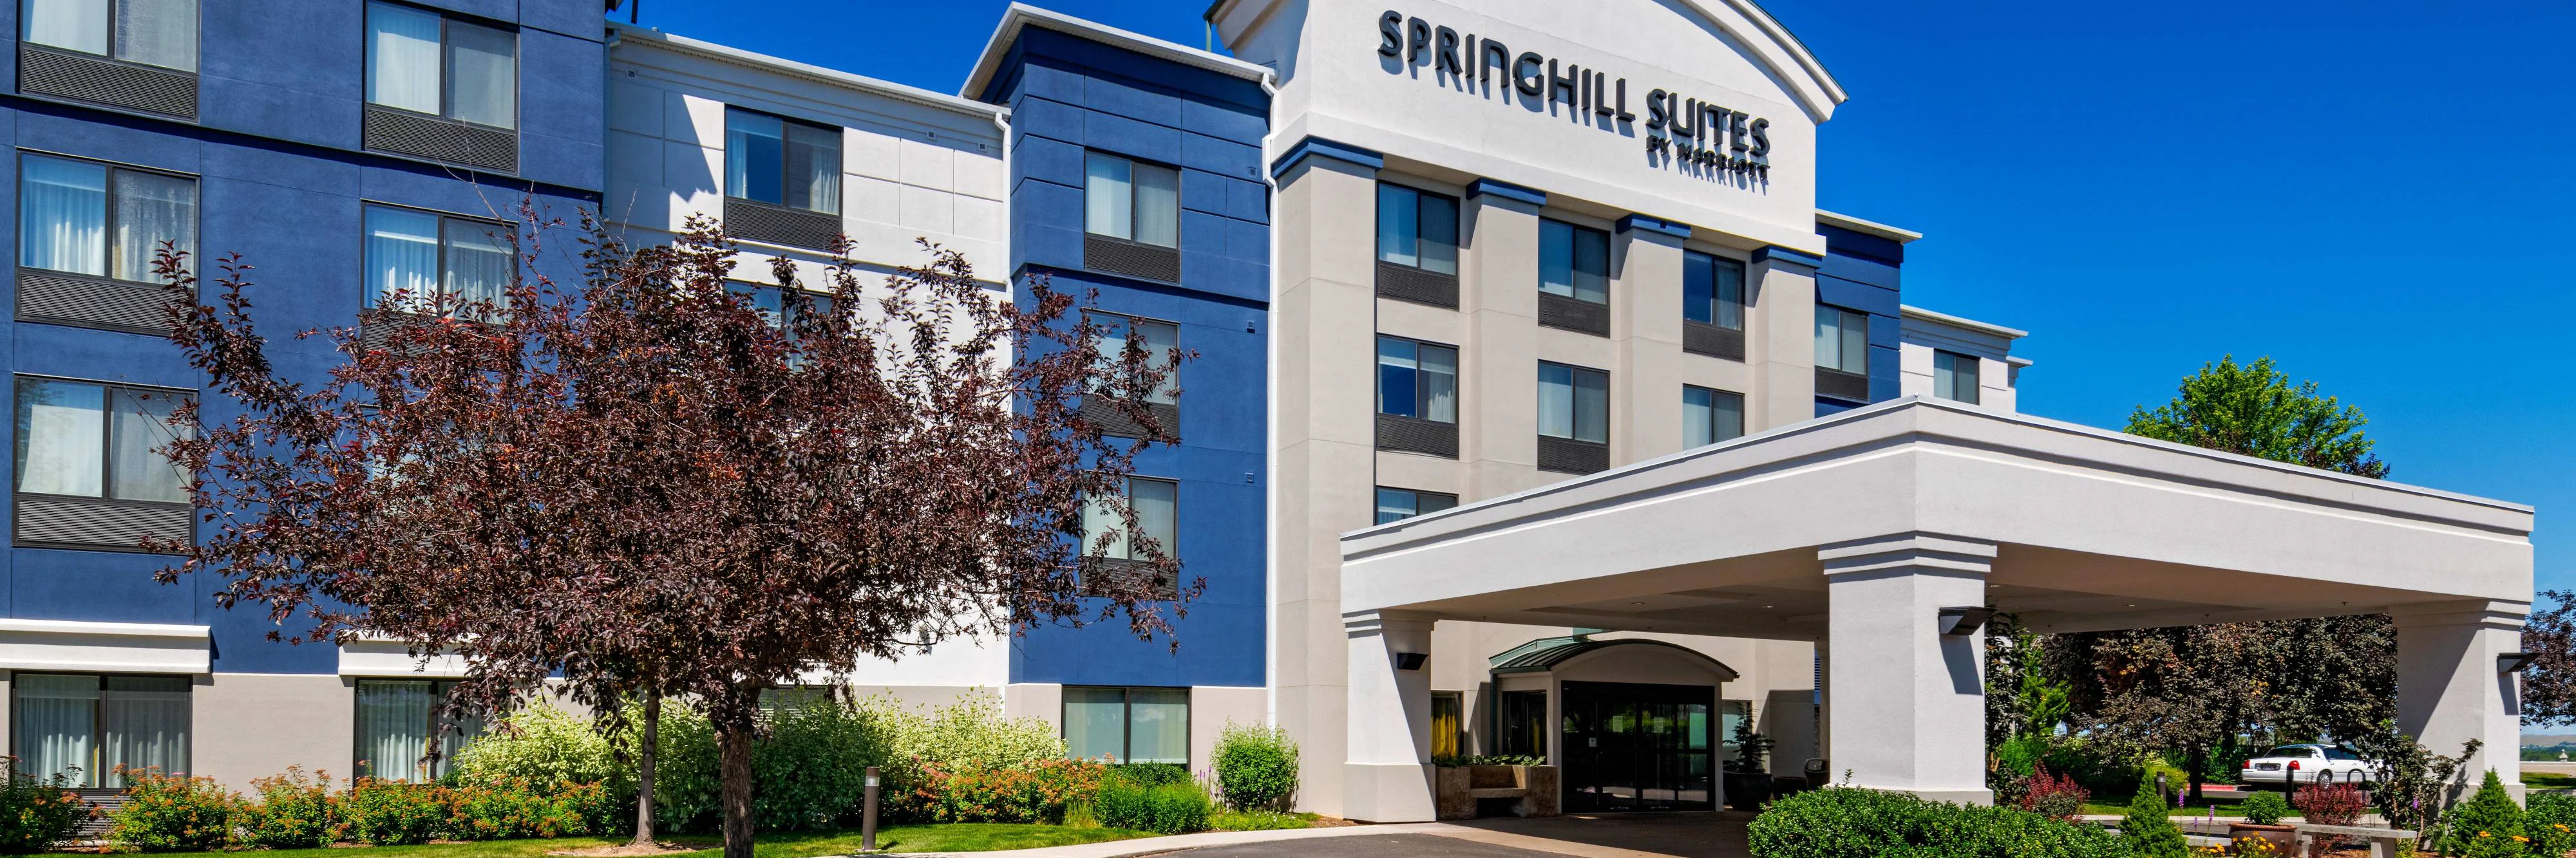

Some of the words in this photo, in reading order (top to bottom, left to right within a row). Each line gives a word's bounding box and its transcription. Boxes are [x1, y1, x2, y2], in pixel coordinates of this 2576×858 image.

[1378, 10, 1635, 122] SPRINGHILL
[1645, 88, 1770, 157] SUITES
[1646, 135, 1672, 154] BY
[1677, 142, 1770, 180] MARRIOTT
